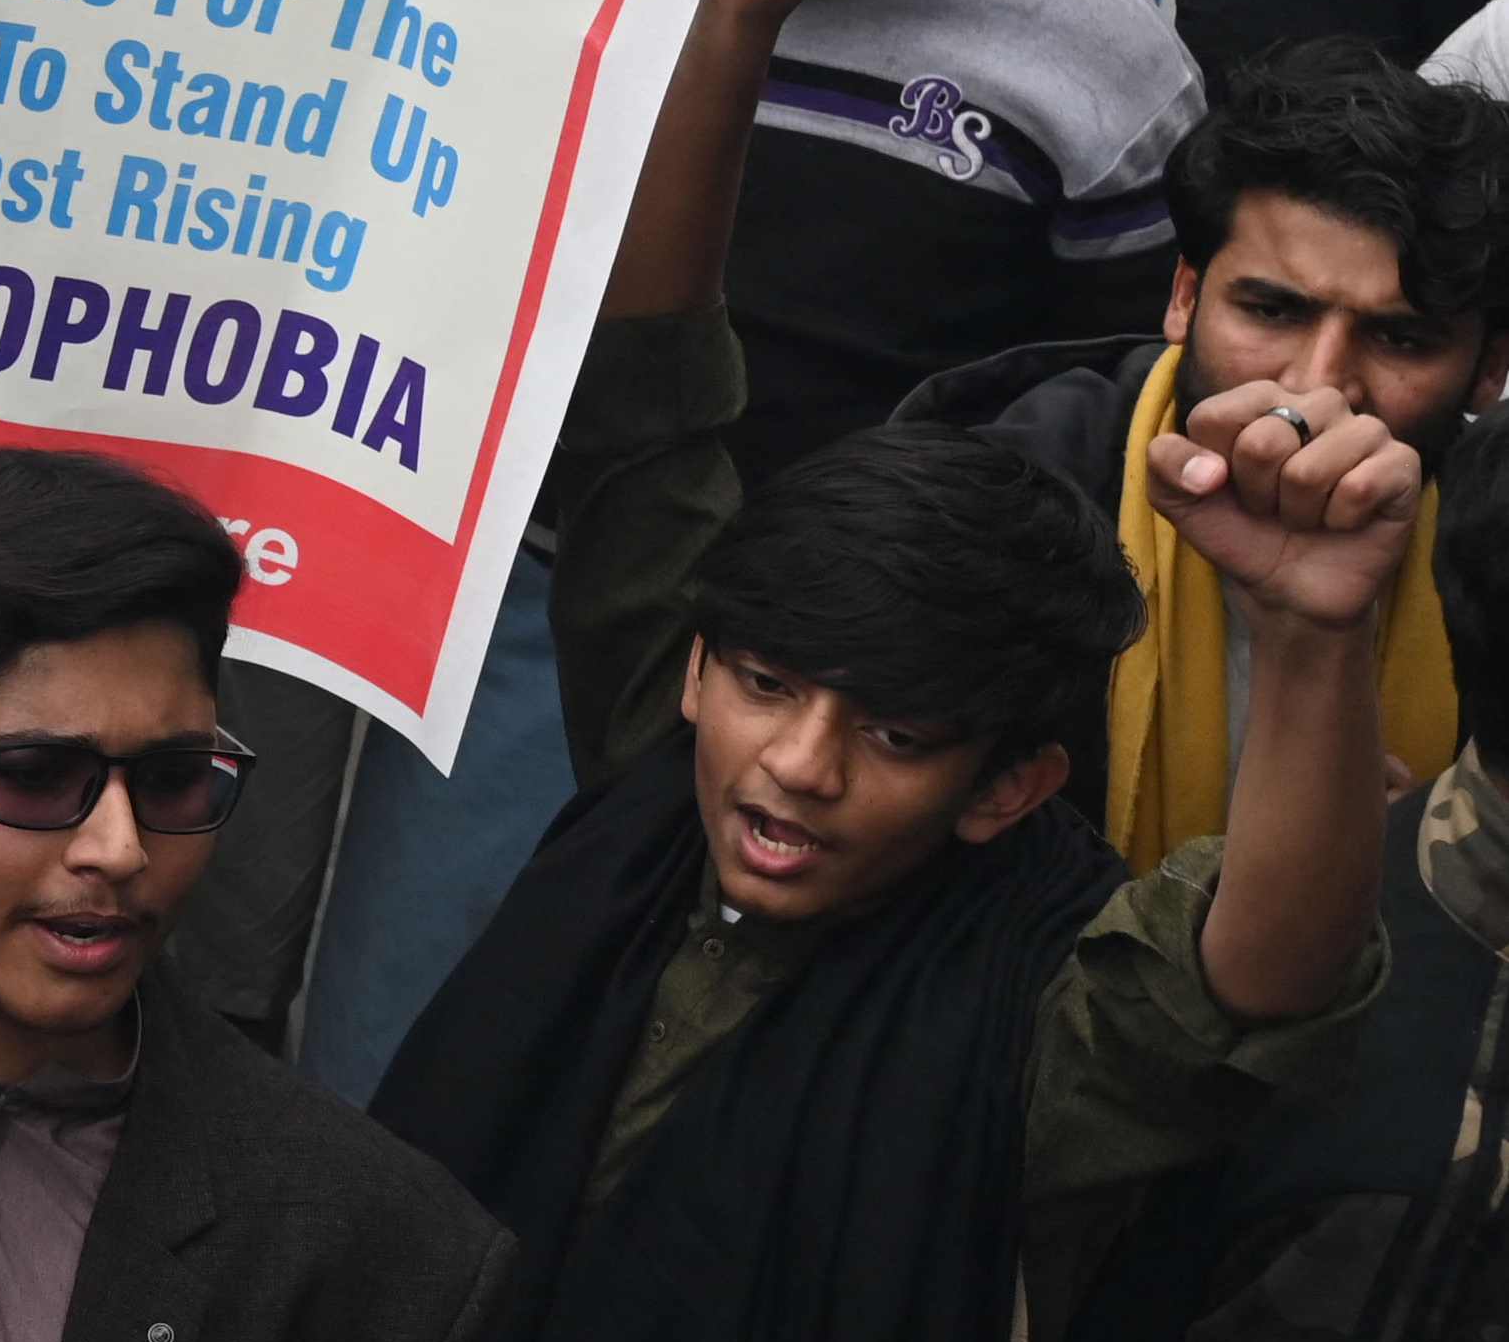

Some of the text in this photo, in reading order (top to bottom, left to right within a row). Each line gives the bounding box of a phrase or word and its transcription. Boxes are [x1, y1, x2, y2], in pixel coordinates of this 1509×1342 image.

[93, 38, 349, 158] Stand
[369, 92, 460, 219] Up
[888, 74, 992, 181] BS
[105, 153, 369, 293] Rising
